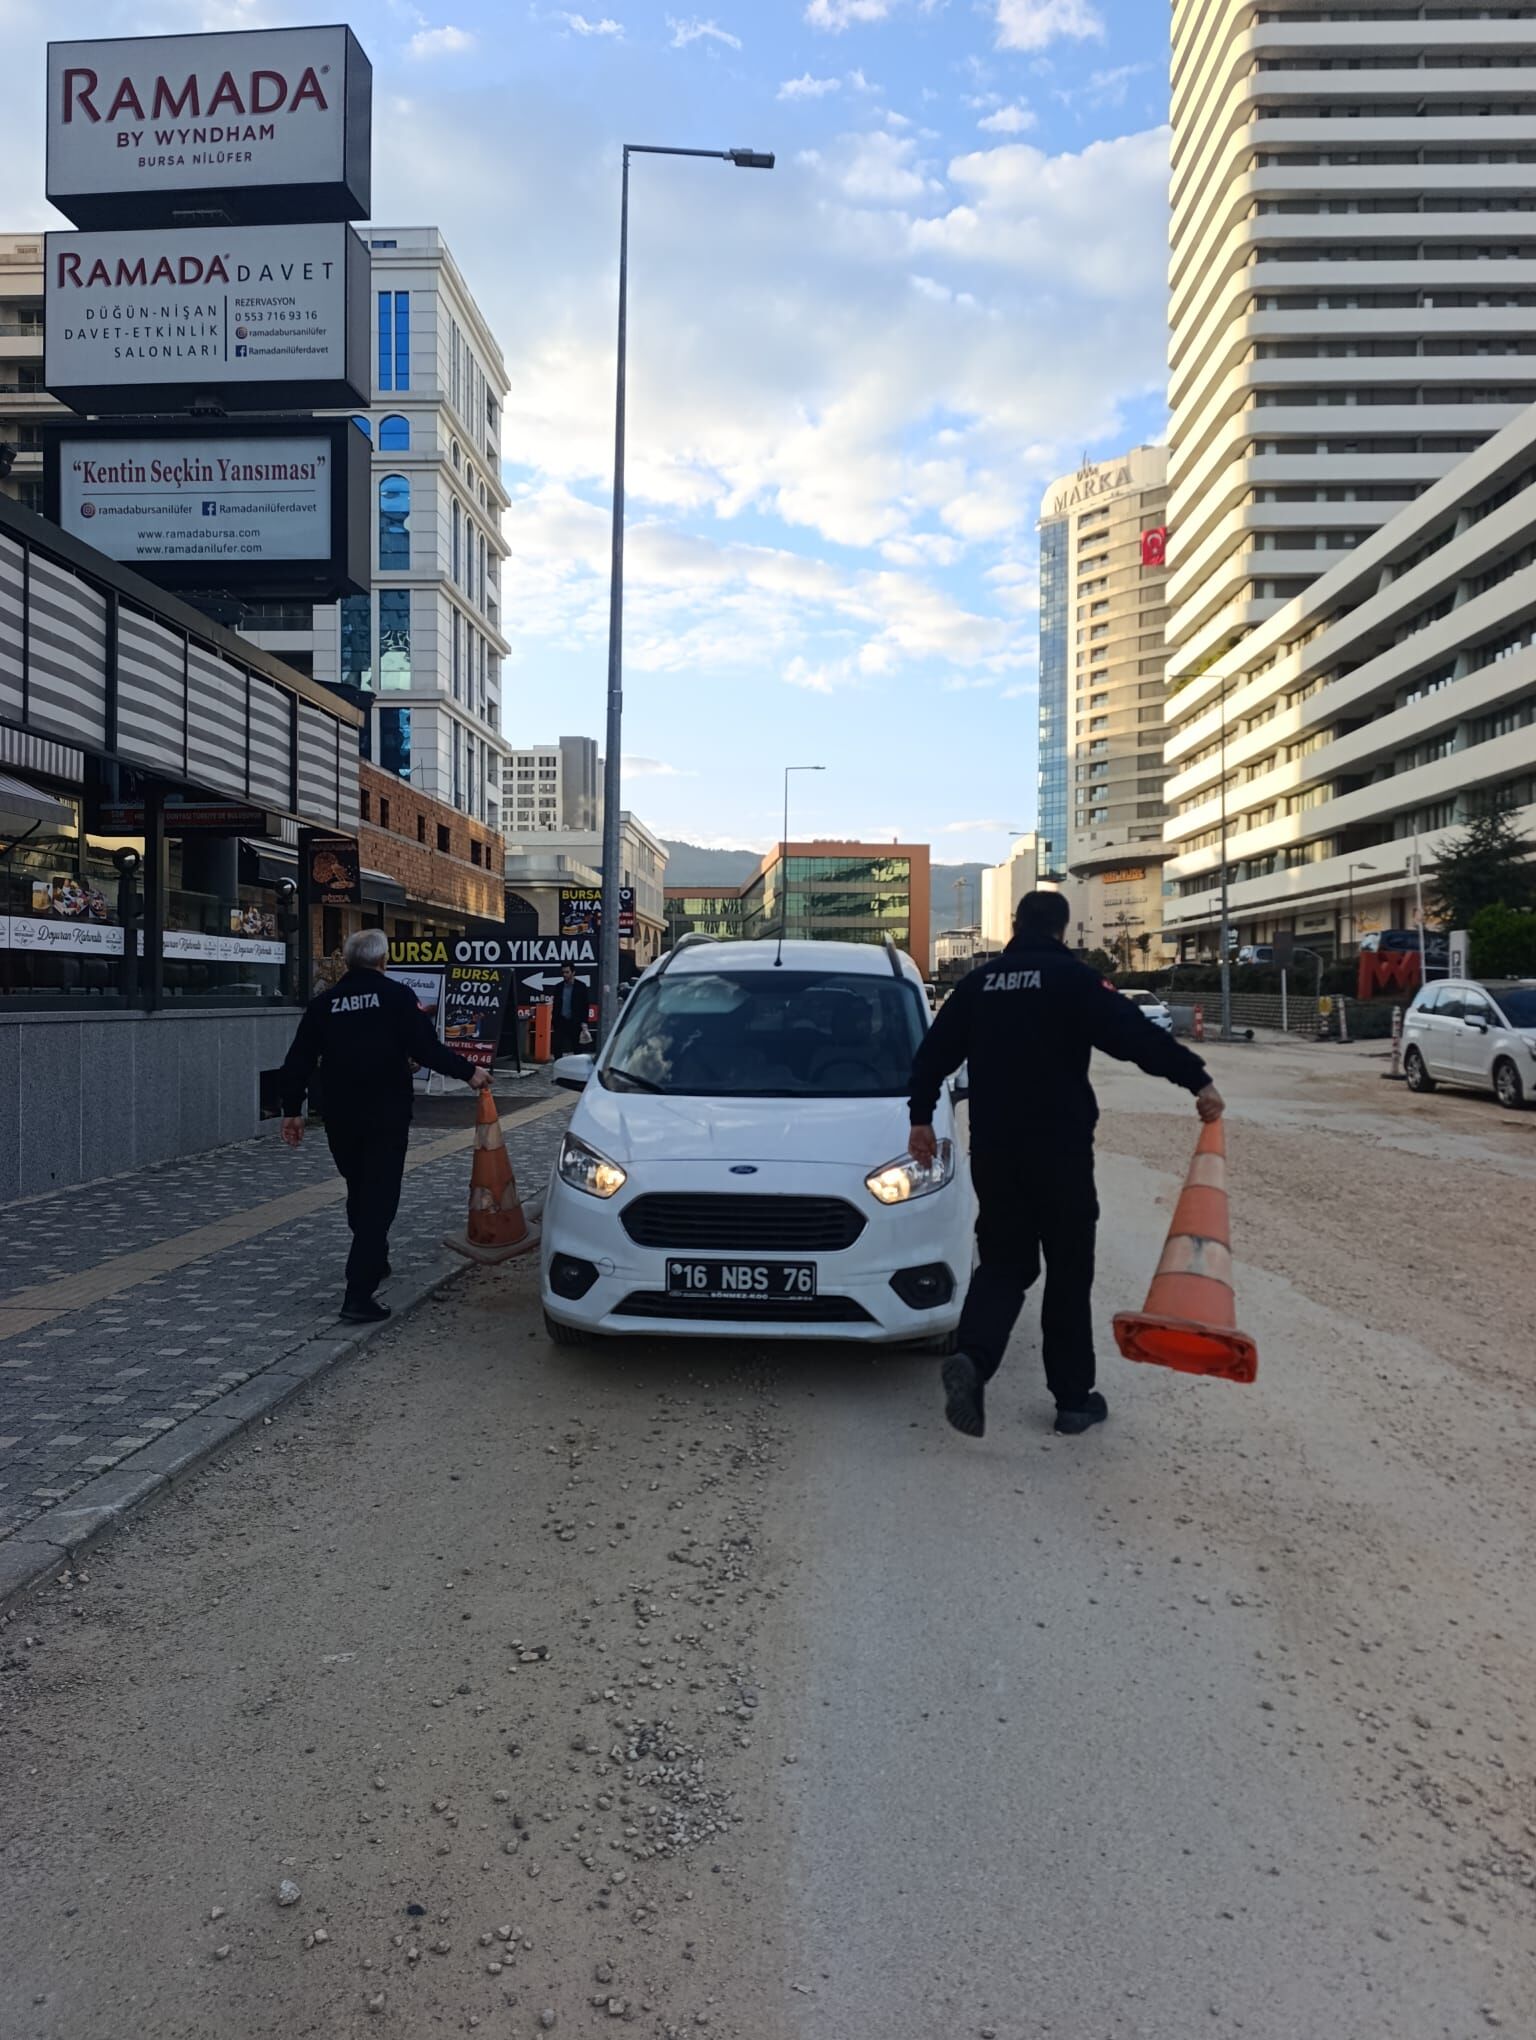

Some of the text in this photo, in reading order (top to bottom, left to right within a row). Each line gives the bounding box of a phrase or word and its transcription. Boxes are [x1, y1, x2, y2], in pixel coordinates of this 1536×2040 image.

[62, 66, 329, 124] RAMADA
[116, 124, 275, 148] BY WYNDHAM
[138, 150, 253, 168] BURSA NİLÜFER
[57, 252, 334, 288] RAMADA DAVET
[234, 297, 296, 307] REZERVASYON
[86, 304, 218, 321] DÜĞÜN-NİŞAN
[234, 310, 318, 322] 0 553 716 93 16
[64, 323, 219, 340] DAVET-ETKİNLİK
[249, 326, 328, 337] ramadabursanilüfer
[115, 344, 218, 359] SALONLARI
[249, 345, 330, 356] Ramadanilüferdavet
[150, 457, 214, 488] Seçkin
[1054, 463, 1132, 512] MARKA
[98, 504, 193, 516] ramadabursanilüfer
[218, 502, 318, 514] Ramadanilüferdavet
[137, 527, 262, 540] www.ramadabursa.com
[136, 541, 263, 555] www.ramadanilufer.com
[561, 890, 602, 900] BURSA
[387, 939, 595, 962] URSA OTO YIKAMA
[451, 967, 500, 981] BURSA
[983, 970, 1042, 992] ZABITA
[460, 981, 492, 994] OTO
[331, 992, 381, 1013] ZABITA
[683, 1264, 812, 1293] 16 NBS 76
